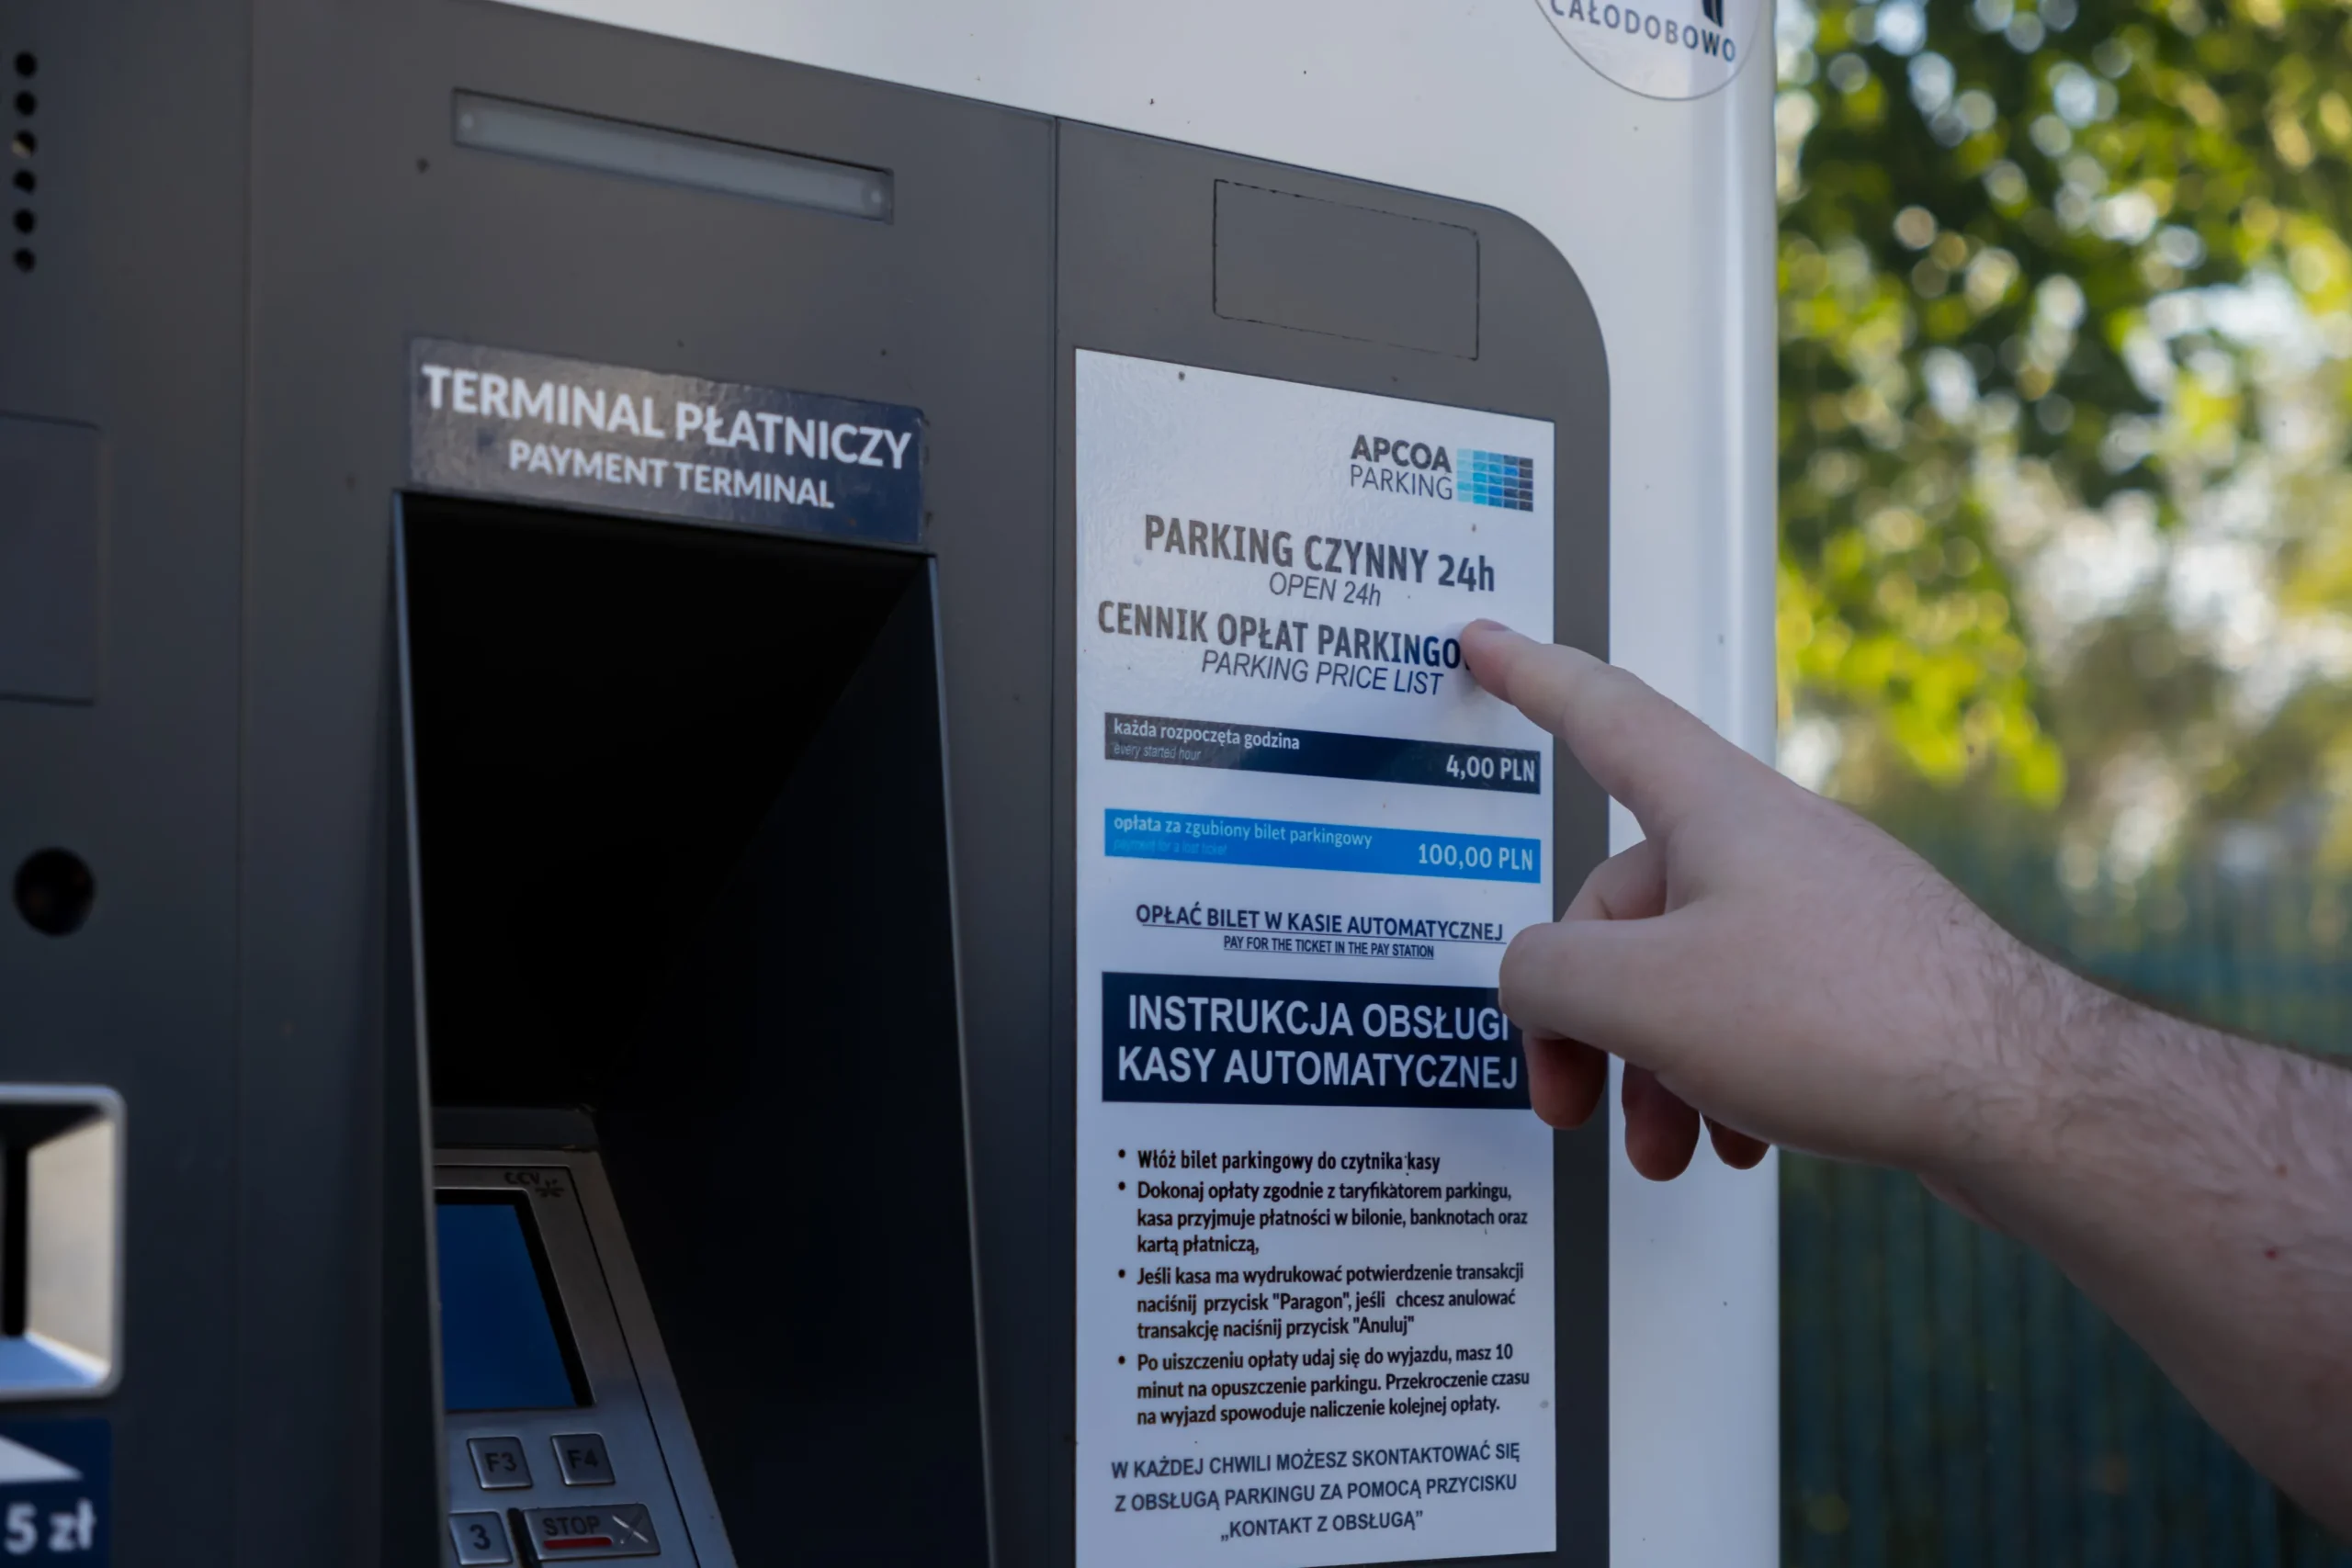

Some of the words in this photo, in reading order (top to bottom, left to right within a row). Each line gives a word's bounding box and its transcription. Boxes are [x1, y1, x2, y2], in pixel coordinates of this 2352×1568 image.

[1551, 0, 1736, 62] CAŁODOBOWO
[422, 365, 666, 440] TERMINAL
[676, 401, 910, 469] PŁATNICZY
[1351, 434, 1452, 474] APCOA
[509, 440, 665, 487] PAYMENT
[673, 461, 834, 509] TERMINAL
[1351, 465, 1453, 500] PARKING
[1146, 514, 1293, 568] PARKING
[1305, 535, 1428, 583] CZYNNY
[1438, 555, 1494, 592] 24h
[1270, 572, 1337, 602] OPEN
[1343, 581, 1381, 606] 24h
[1098, 601, 1207, 643] CENNIK
[1217, 613, 1307, 652] OPŁAT
[1317, 625, 1471, 670] PARKINGO
[1202, 649, 1307, 682] PARKING
[1316, 663, 1385, 691] PRICE
[1393, 669, 1443, 694] LIST
[1114, 718, 1156, 738] każda
[1160, 727, 1240, 746] rozpoczęta
[1245, 731, 1299, 750] godzina
[1114, 743, 1140, 759] every
[1143, 745, 1176, 760] started
[1179, 747, 1202, 761] hour
[1446, 755, 1494, 780] 4,00
[1500, 758, 1535, 782] PLN
[1114, 815, 1160, 832] opłata
[1166, 818, 1181, 833] za
[1186, 819, 1250, 840] zgubiony
[1255, 823, 1285, 840] bilet
[1290, 828, 1373, 849] parkingowy
[1419, 844, 1492, 870] 100,00
[1499, 847, 1532, 871] PLN
[1136, 901, 1202, 926] OPŁAĆ
[1207, 908, 1260, 928] BILET
[1264, 911, 1283, 930] W
[1288, 912, 1341, 933] KASIE
[1347, 917, 1503, 942] AUTOMATYCZNEJ
[1224, 935, 1243, 949] PAY
[1247, 937, 1269, 950] FOR
[1272, 938, 1292, 951] THE
[1295, 939, 1332, 953] TICKET
[1335, 941, 1345, 953] IN
[1348, 942, 1368, 955] THE
[1371, 943, 1391, 956] PAY
[1393, 944, 1433, 957] STATION
[1129, 994, 1354, 1036] INSTRUKCJA
[1363, 1003, 1509, 1041] OBSŁUGI
[1119, 1045, 1216, 1082] KASY
[1223, 1049, 1517, 1089] AUTOMATYCZNEJ
[1138, 1149, 1176, 1168] Włóż
[1182, 1150, 1216, 1168] bilet
[1222, 1151, 1313, 1173] parkingowy
[1318, 1152, 1336, 1169] do
[1341, 1152, 1402, 1173] czytnika
[1408, 1153, 1441, 1174] kasy
[504, 1170, 539, 1185] CCV
[1138, 1181, 1204, 1201] Dokonaj
[1209, 1182, 1259, 1201] opłaty
[1263, 1181, 1323, 1201] zgodnie
[1328, 1186, 1335, 1199] z
[1340, 1182, 1442, 1201] taryfikatorem
[1445, 1182, 1511, 1201] parkingu,
[1137, 1209, 1172, 1226] kasa
[1178, 1209, 1255, 1230] przyjmuje
[1260, 1208, 1330, 1229] płatności
[1335, 1213, 1347, 1224] w
[1352, 1208, 1406, 1227] bilonie,
[1410, 1208, 1494, 1225] banknotach
[1498, 1212, 1527, 1224] oraz
[1137, 1235, 1178, 1256] kartą
[1183, 1235, 1259, 1255] płatniczą,
[1136, 1267, 1170, 1284] Jeśli
[1176, 1267, 1211, 1284] kasa
[1216, 1271, 1238, 1283] ma
[1243, 1265, 1342, 1286] wydrukować
[1346, 1264, 1452, 1284] potwierdzenie
[1456, 1262, 1523, 1282] transakcji
[1137, 1294, 1196, 1315] naciśnij
[1204, 1293, 1268, 1315] przycisk
[1272, 1292, 1351, 1313] "Paragon",
[1355, 1291, 1385, 1312] jeśli
[1396, 1291, 1444, 1307] chcesz
[1449, 1289, 1515, 1306] anulować
[1137, 1320, 1218, 1341] transakcję
[1223, 1319, 1282, 1339] naciśnij
[1286, 1317, 1350, 1338] przycisk
[1353, 1315, 1414, 1336] "Anuluj"
[1137, 1354, 1158, 1371] Po
[1163, 1351, 1243, 1370] uiszczeniu
[1248, 1349, 1298, 1371] opłaty
[1303, 1348, 1334, 1368] udaj
[1340, 1348, 1360, 1368] się
[1365, 1348, 1383, 1364] do
[1387, 1346, 1452, 1366] wyjazdu,
[1456, 1347, 1491, 1361] masz
[1496, 1344, 1513, 1359] 10
[1137, 1381, 1183, 1398] minut
[1188, 1385, 1206, 1397] na
[1212, 1377, 1306, 1399] opuszczenie
[1310, 1375, 1381, 1396] parkingu.
[1385, 1371, 1487, 1391] Przekroczenie
[1491, 1372, 1530, 1386] czasu
[1137, 1412, 1156, 1425] na
[1160, 1404, 1216, 1427] wyjazd
[1220, 1403, 1306, 1424] spowoduje
[1310, 1398, 1385, 1418] naliczenie
[1389, 1396, 1446, 1417] kolejnej
[1451, 1394, 1499, 1415] opłaty.
[484, 1452, 517, 1472] F3
[567, 1449, 599, 1468] F4
[1112, 1461, 1128, 1479] W
[1134, 1456, 1204, 1478] KAŻDEJ
[1209, 1455, 1271, 1474] CHWILI
[1276, 1449, 1347, 1471] MOŻESZ
[1352, 1439, 1490, 1467] SKONTAKTOWAĆ
[1496, 1442, 1520, 1462] SIĘ
[1114, 1495, 1125, 1512] Z
[1131, 1490, 1220, 1511] OBSŁUGĄ
[1225, 1485, 1315, 1506] PARKINGU
[1320, 1483, 1342, 1500] ZA
[1347, 1480, 1421, 1499] POMOCĄ
[1427, 1473, 1517, 1495] PRZYCISKU
[5, 1500, 39, 1556] 5
[48, 1496, 96, 1552] zł
[469, 1525, 491, 1550] 3
[543, 1516, 601, 1536] STOP
[1220, 1517, 1312, 1542] „KONTAKT
[1317, 1517, 1328, 1532] Z
